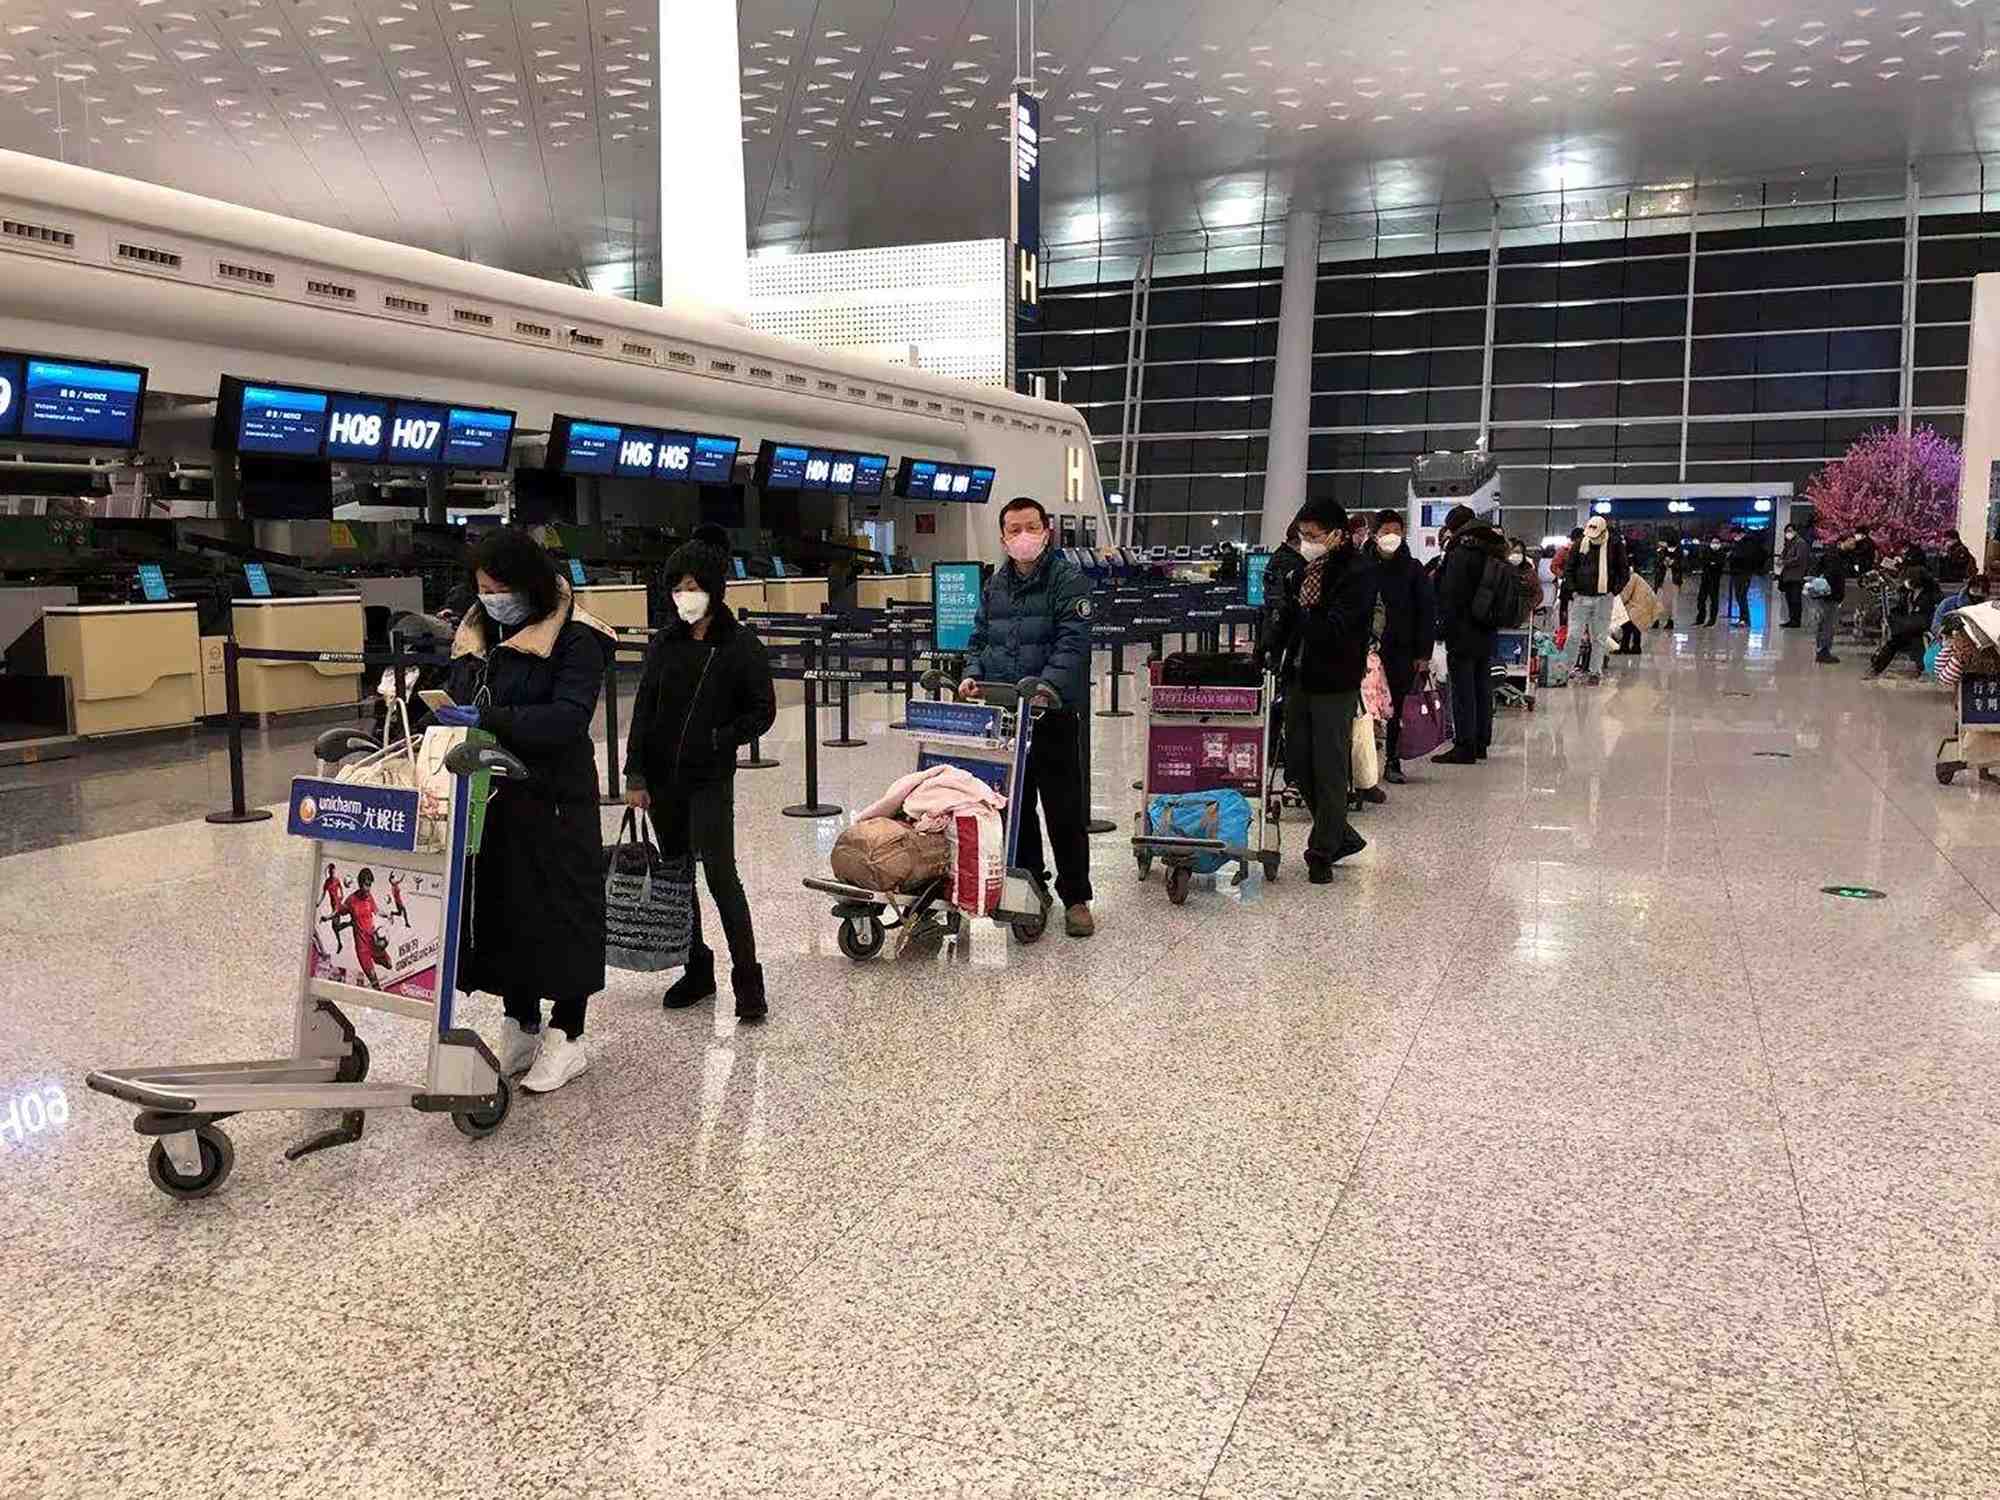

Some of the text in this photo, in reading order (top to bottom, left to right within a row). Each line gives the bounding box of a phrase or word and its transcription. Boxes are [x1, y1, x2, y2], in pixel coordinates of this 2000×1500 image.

[1020, 248, 1037, 305] H
[329, 412, 382, 446] H08
[391, 418, 441, 450] H07
[620, 440, 655, 467] H06
[657, 444, 691, 470] H05
[804, 459, 830, 482] H04
[1067, 447, 1084, 503] H
[319, 796, 362, 814] unicharm
